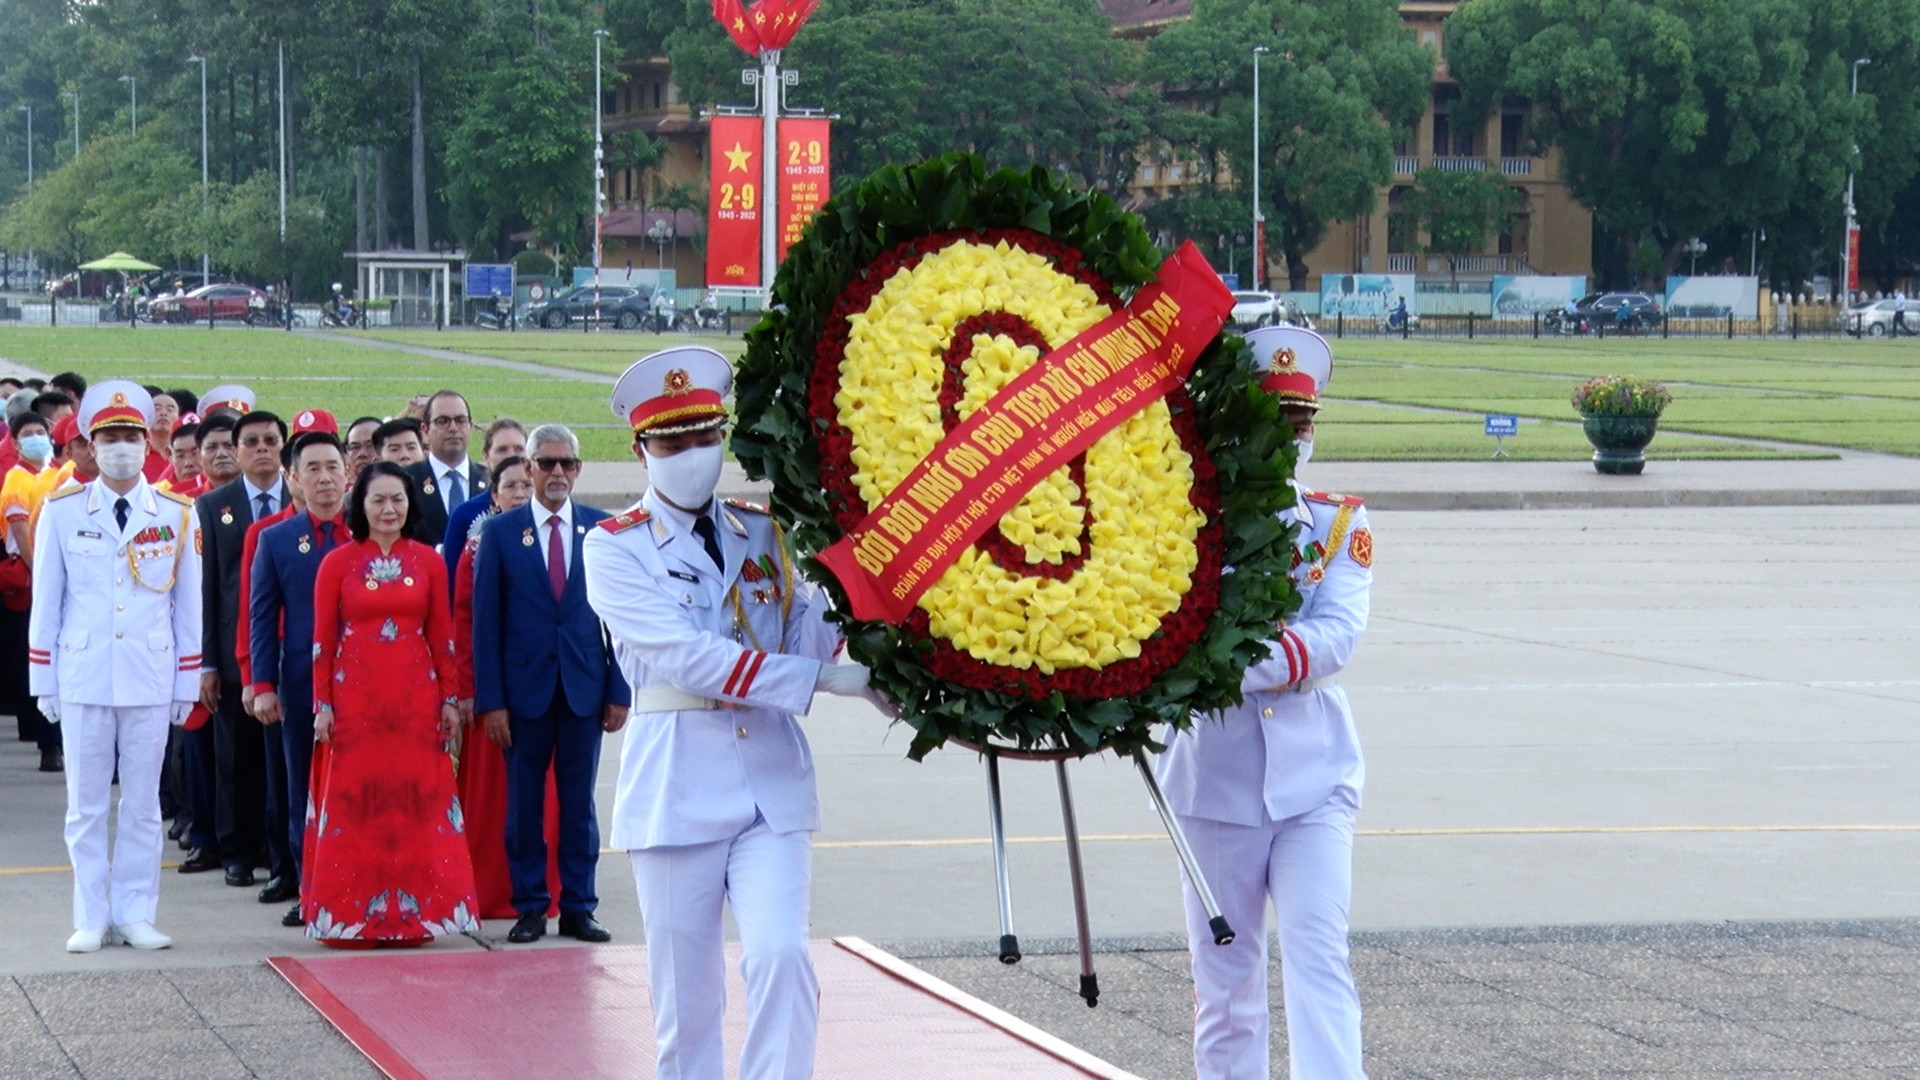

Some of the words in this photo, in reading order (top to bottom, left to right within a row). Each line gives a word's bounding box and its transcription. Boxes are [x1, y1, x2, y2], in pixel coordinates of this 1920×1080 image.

[788, 141, 821, 165] 2-9
[785, 166, 802, 174] 1945
[808, 166, 824, 174] 2022
[720, 183, 754, 210] 2-9
[718, 210, 734, 220] 1945
[740, 210, 756, 220] 2022
[853, 529, 900, 577] ĐỜI
[878, 498, 929, 544] ĐỜI
[906, 460, 962, 514] NHỚ
[945, 442, 990, 478] ƠN
[970, 406, 1024, 456] CHỦ
[1002, 383, 1060, 431] TỊCH
[1040, 360, 1082, 404] HỒ
[1065, 342, 1110, 387] CHÍ
[1090, 326, 1147, 374] MINH
[1140, 291, 1181, 336] ĐẠI
[892, 570, 920, 600] ĐOÀN
[926, 540, 948, 560] ĐẠI
[941, 524, 963, 545] HỘI
[956, 514, 972, 530] XI
[966, 500, 988, 520] HỘI
[1000, 465, 1024, 486] VIỆT
[1019, 450, 1044, 470] NAM
[1037, 437, 1056, 456] VÀ
